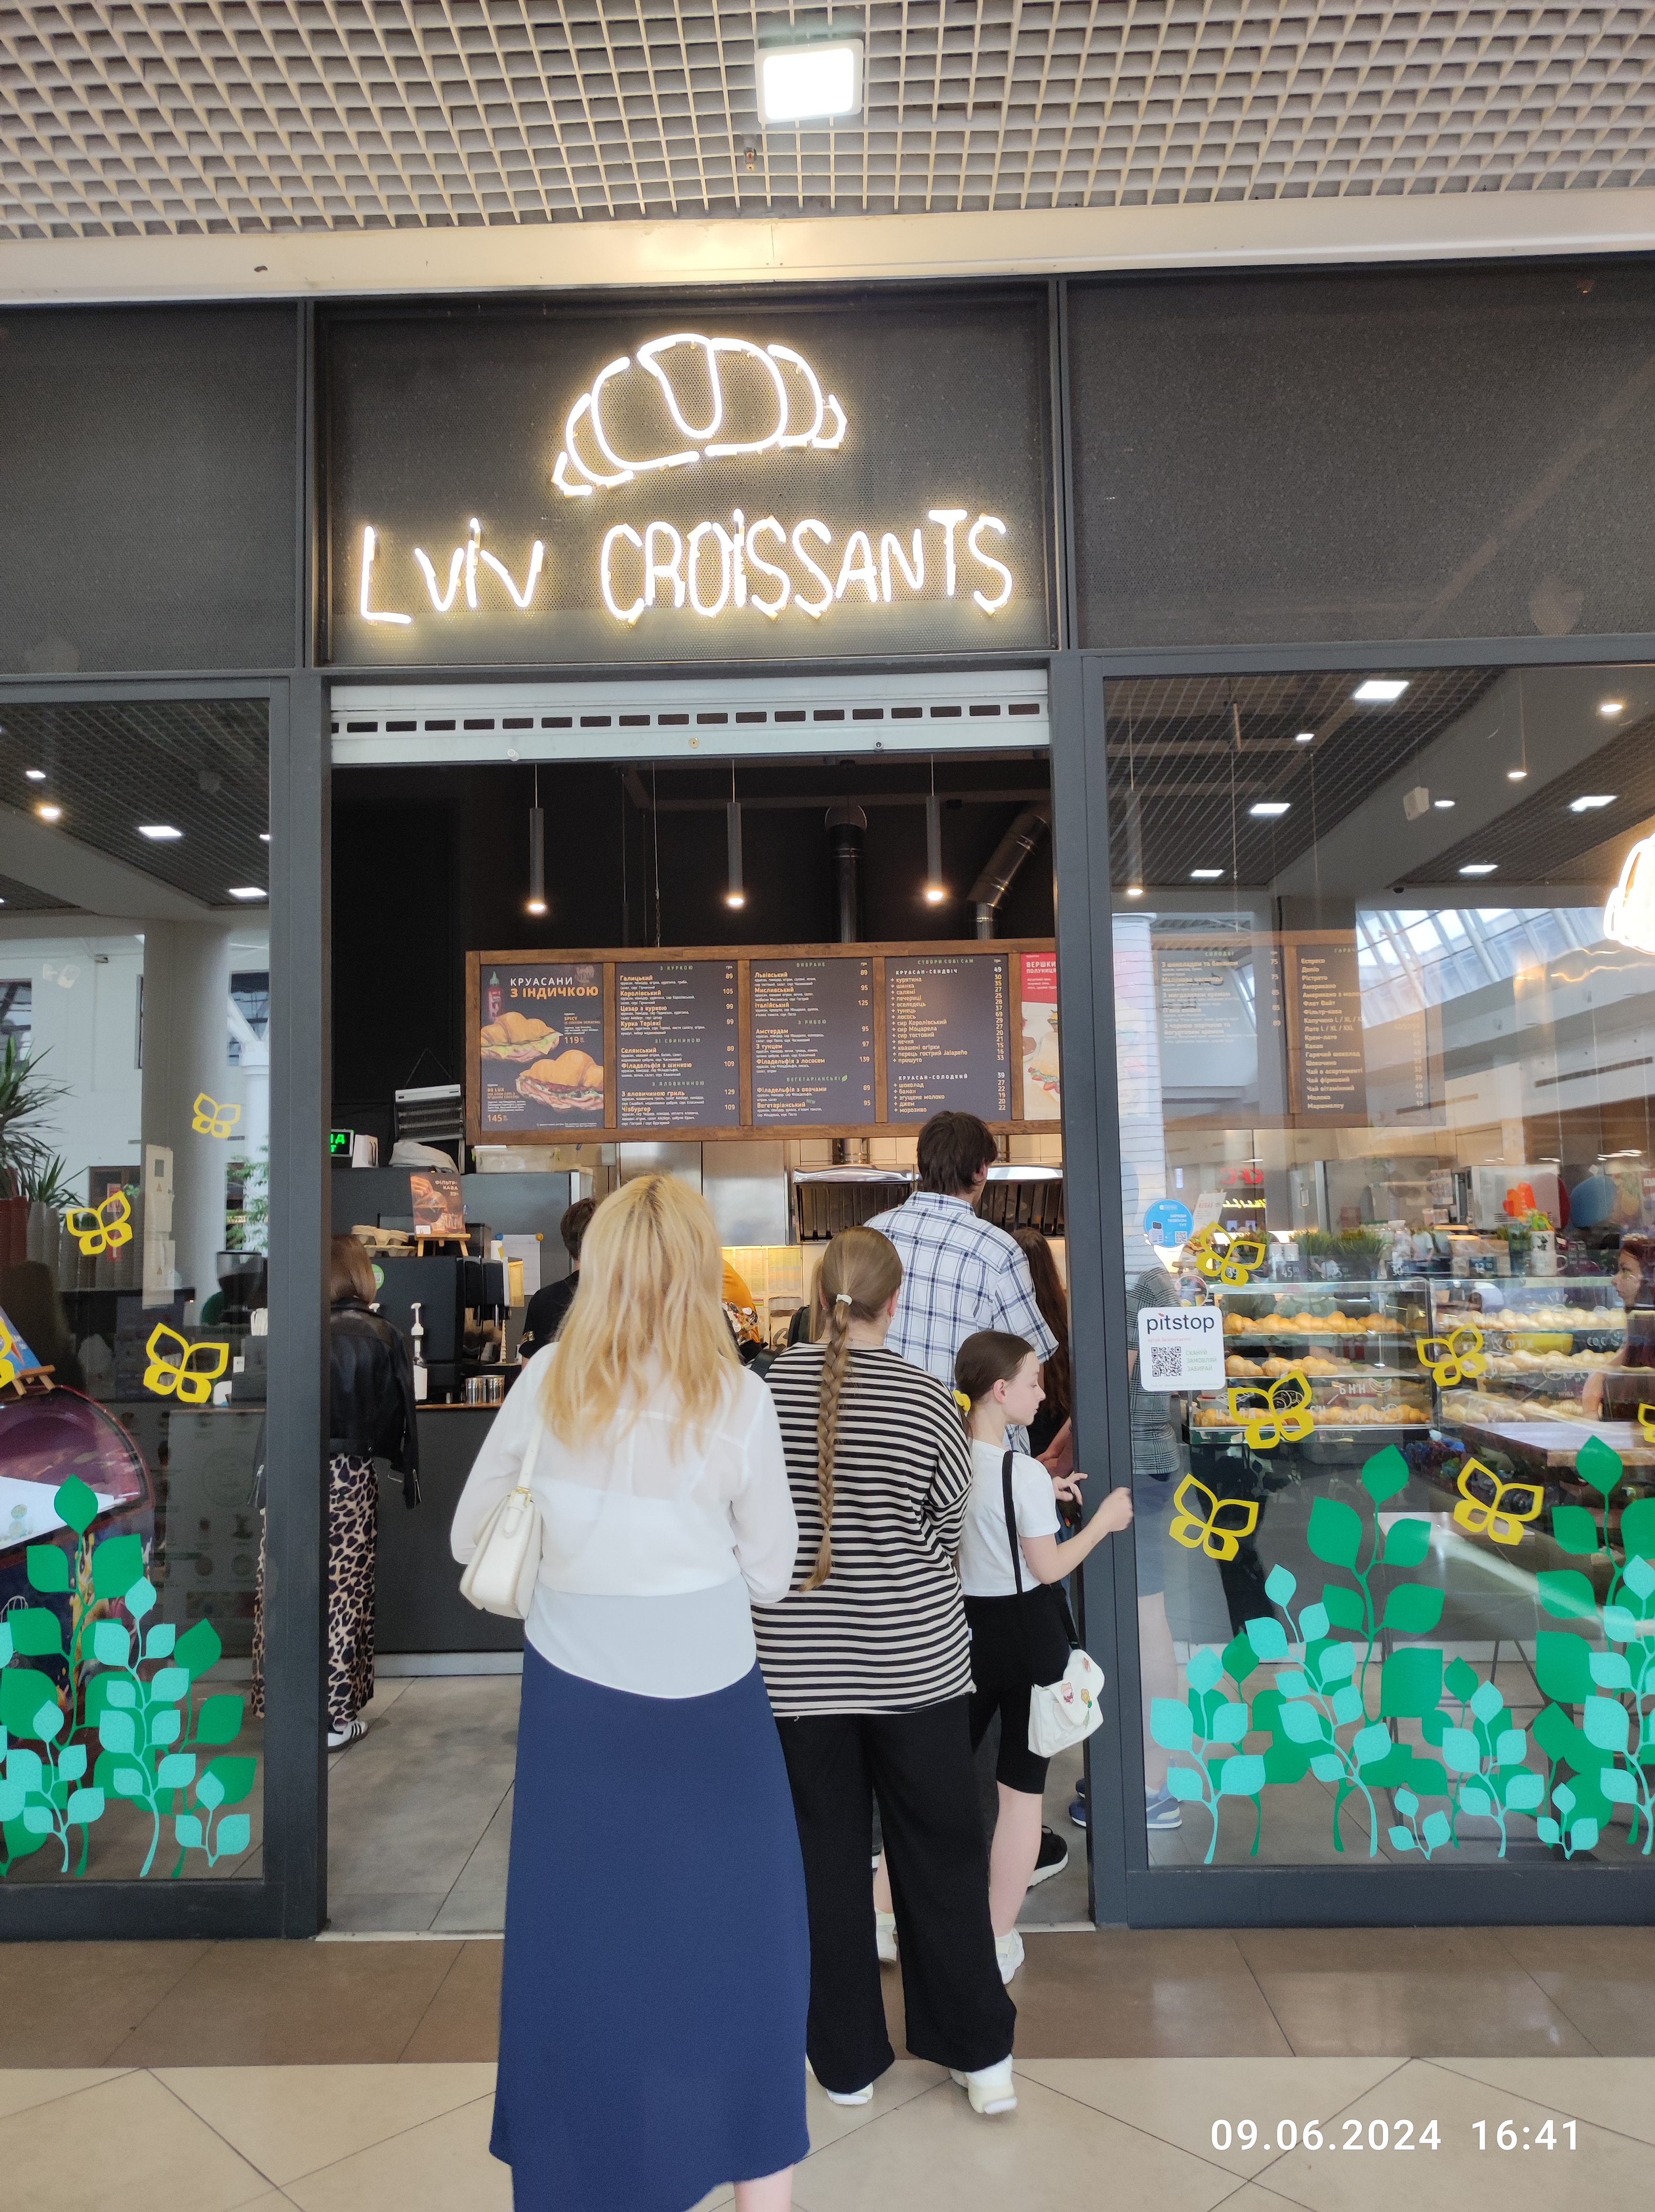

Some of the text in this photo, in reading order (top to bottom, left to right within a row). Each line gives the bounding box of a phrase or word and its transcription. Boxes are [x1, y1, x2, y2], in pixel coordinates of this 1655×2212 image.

[510, 976, 572, 986] КРУАСАНИ
[510, 986, 599, 1000] З ІНДИЧКОЮ
[1282, 1267, 1293, 1278] 45
[1147, 1312, 1215, 1334] pitstop
